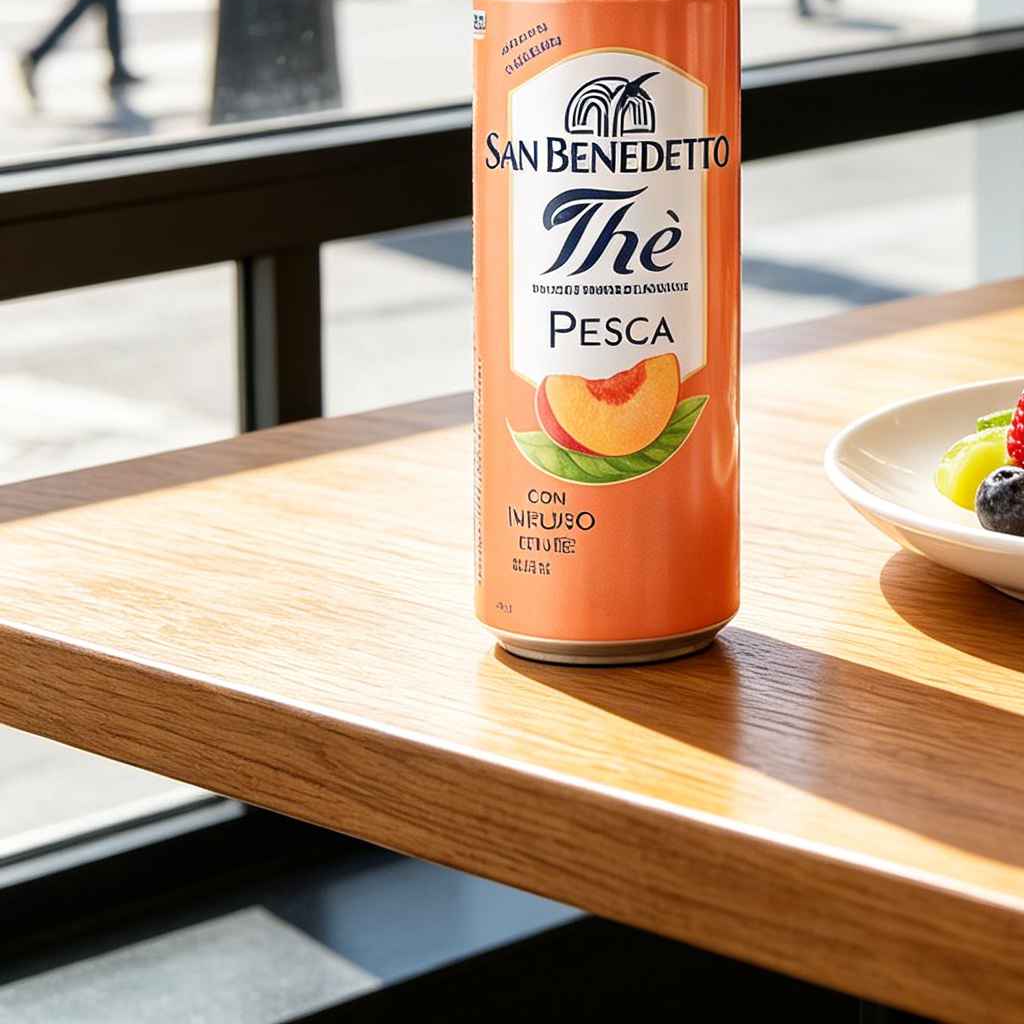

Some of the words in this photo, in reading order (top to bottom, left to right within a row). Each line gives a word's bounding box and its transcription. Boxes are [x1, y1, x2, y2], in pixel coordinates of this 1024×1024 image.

[485, 132, 538, 172] SAN
[546, 135, 730, 174] BENEDETTO
[539, 185, 682, 277] Thè
[550, 310, 675, 348] PESCA
[528, 489, 566, 505] CON
